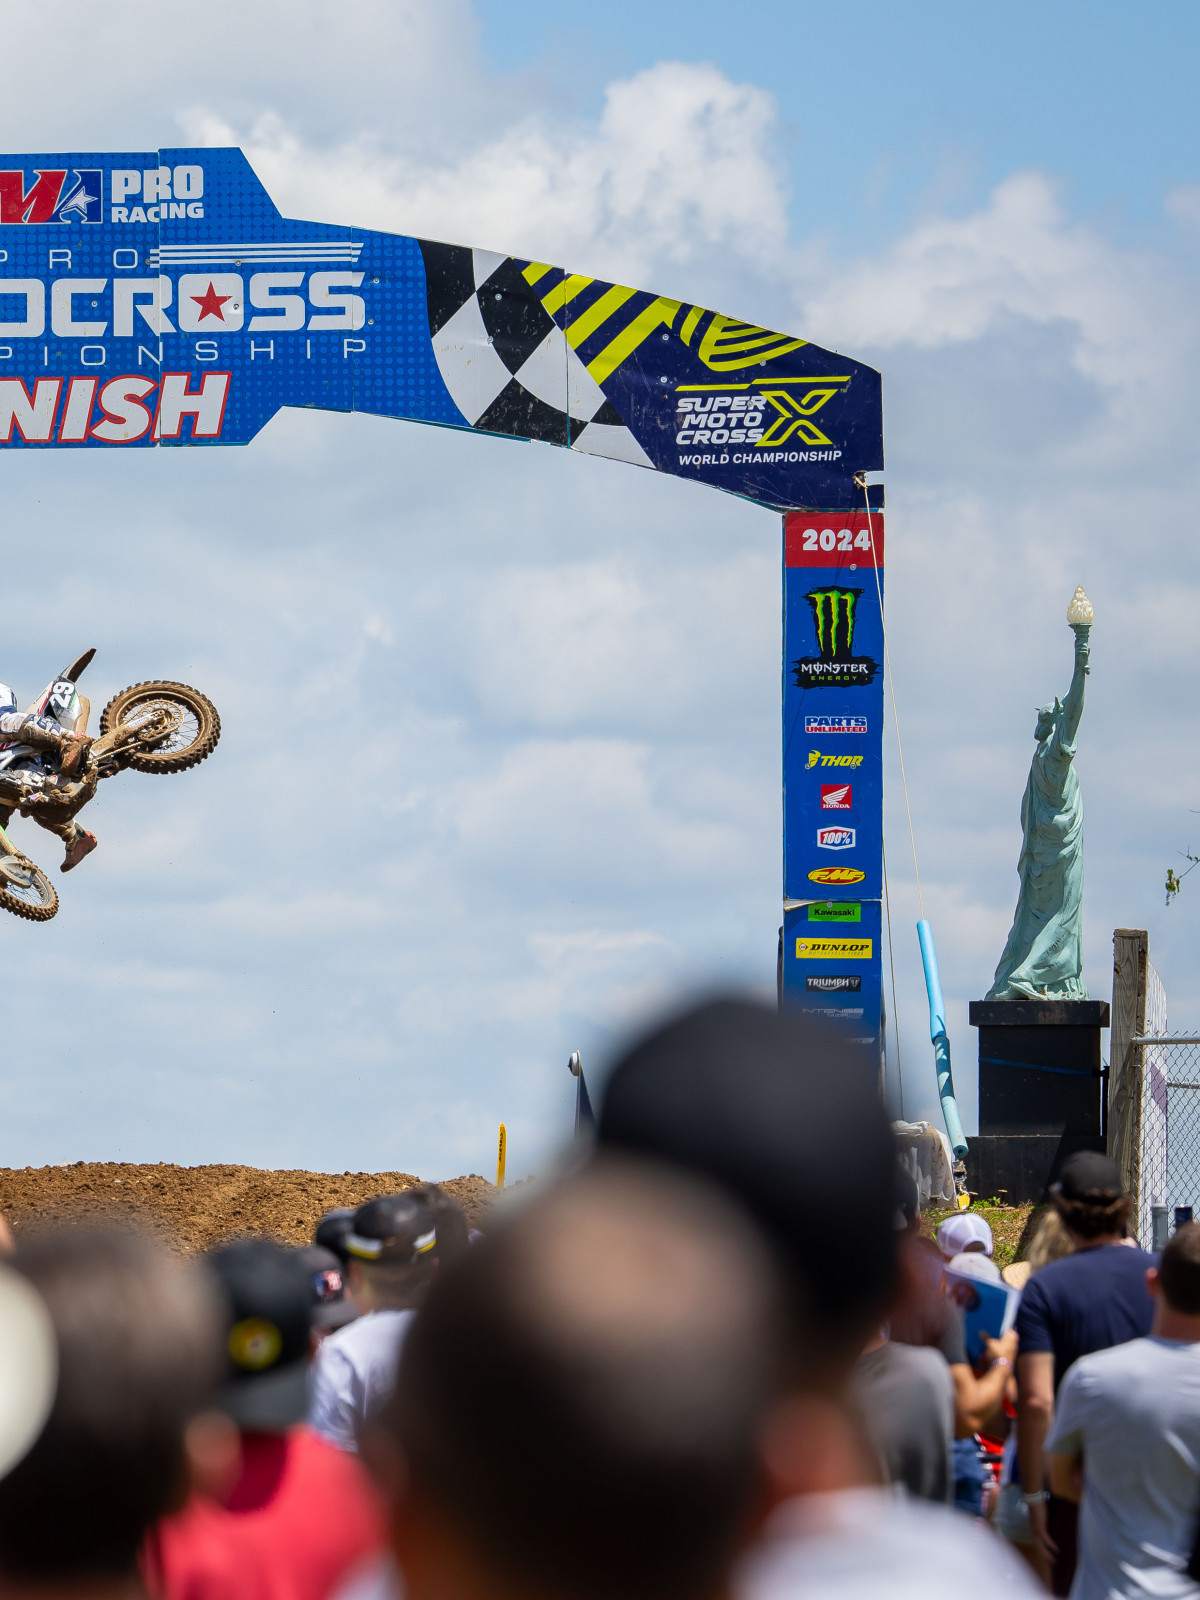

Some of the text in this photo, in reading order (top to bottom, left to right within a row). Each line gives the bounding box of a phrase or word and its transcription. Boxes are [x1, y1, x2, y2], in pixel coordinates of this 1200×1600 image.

[111, 165, 204, 204] PRO
[111, 202, 204, 223] RACING
[676, 395, 767, 412] SUPER
[682, 412, 762, 429] MOTO
[676, 428, 764, 444] CROSS
[679, 450, 842, 466] WORLD CHAMPIONSHIP
[802, 529, 871, 551] 2024
[801, 662, 868, 674] MONSTER
[49, 681, 75, 709] 29
[805, 716, 867, 726] PARTS
[821, 755, 863, 766] THOR
[822, 831, 851, 844] 100%
[809, 870, 865, 880] FMF
[814, 908, 855, 916] Kawasaki
[810, 943, 869, 951] DUNLOP
[807, 978, 849, 989] TRIUMPH
